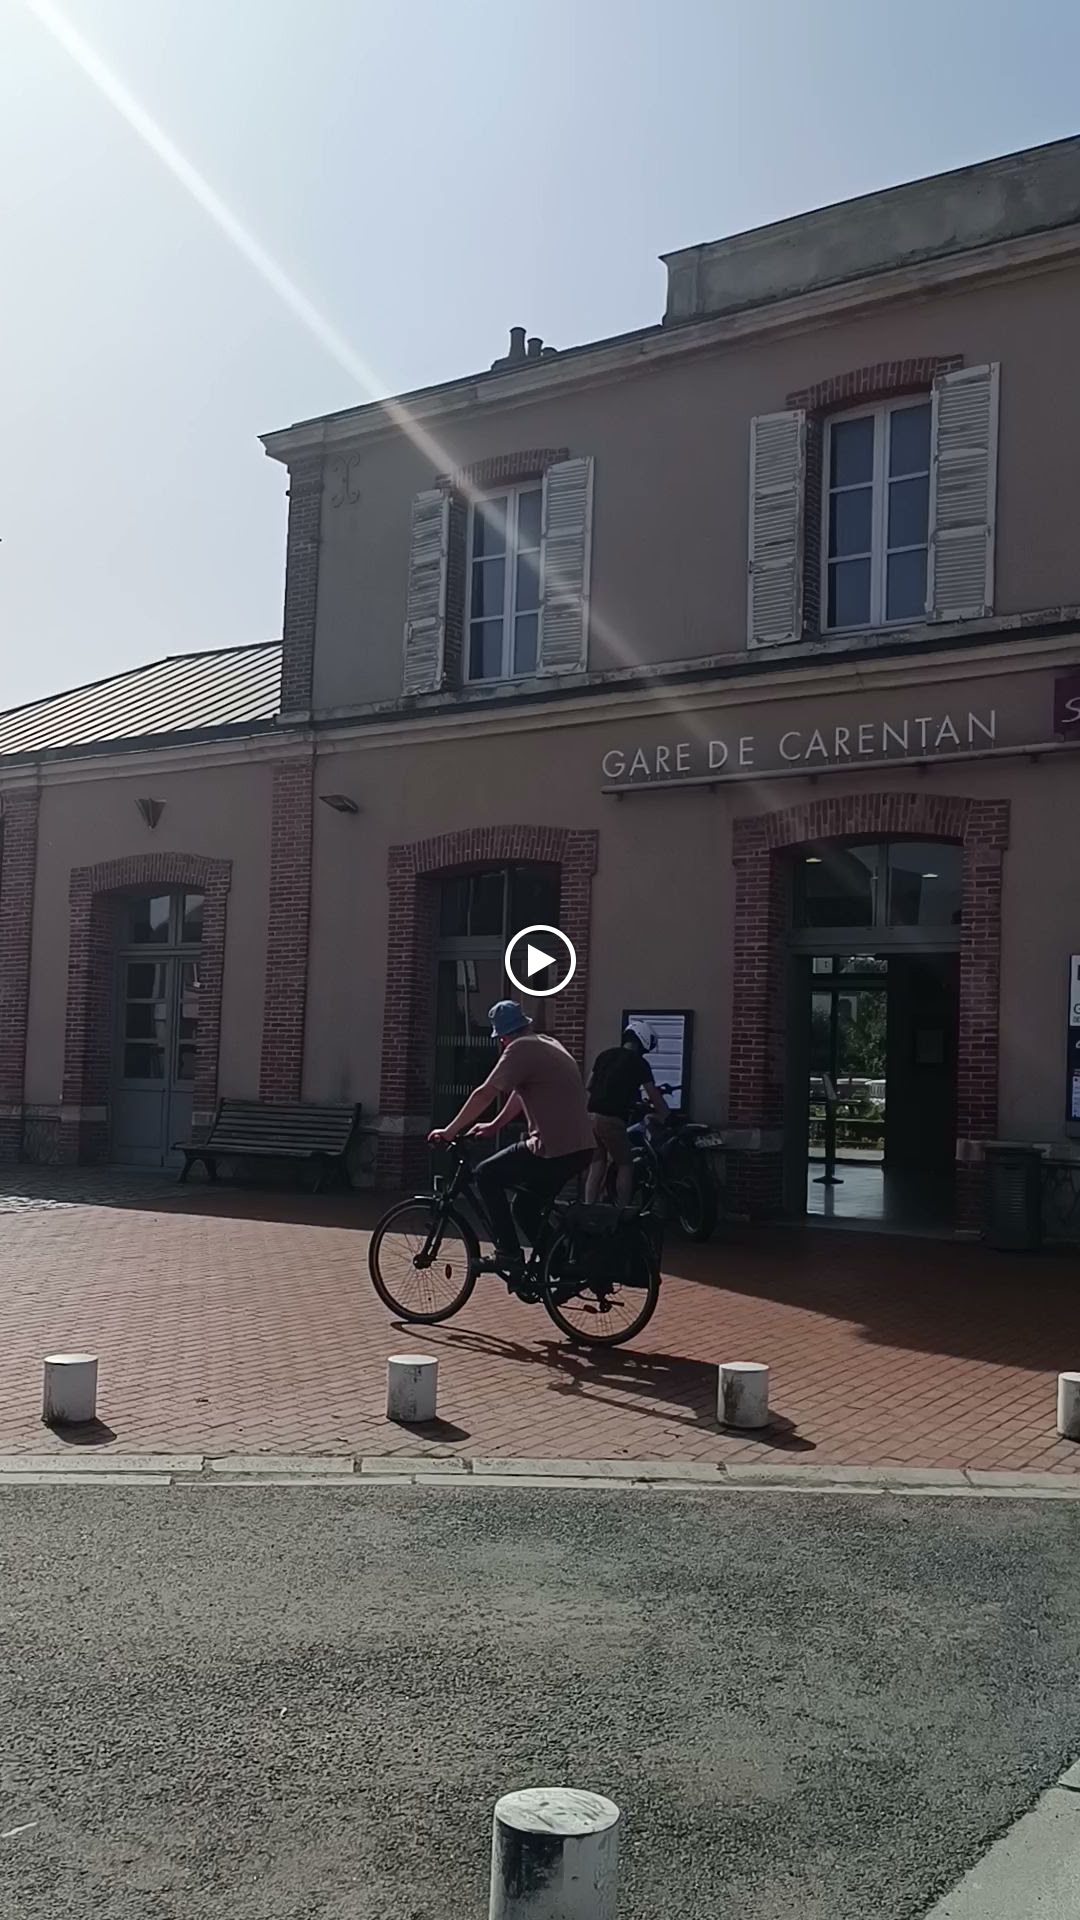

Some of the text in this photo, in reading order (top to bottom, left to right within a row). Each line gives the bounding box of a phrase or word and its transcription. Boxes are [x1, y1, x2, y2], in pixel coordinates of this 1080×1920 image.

[602, 710, 996, 777] GARE DE CARENTAN
